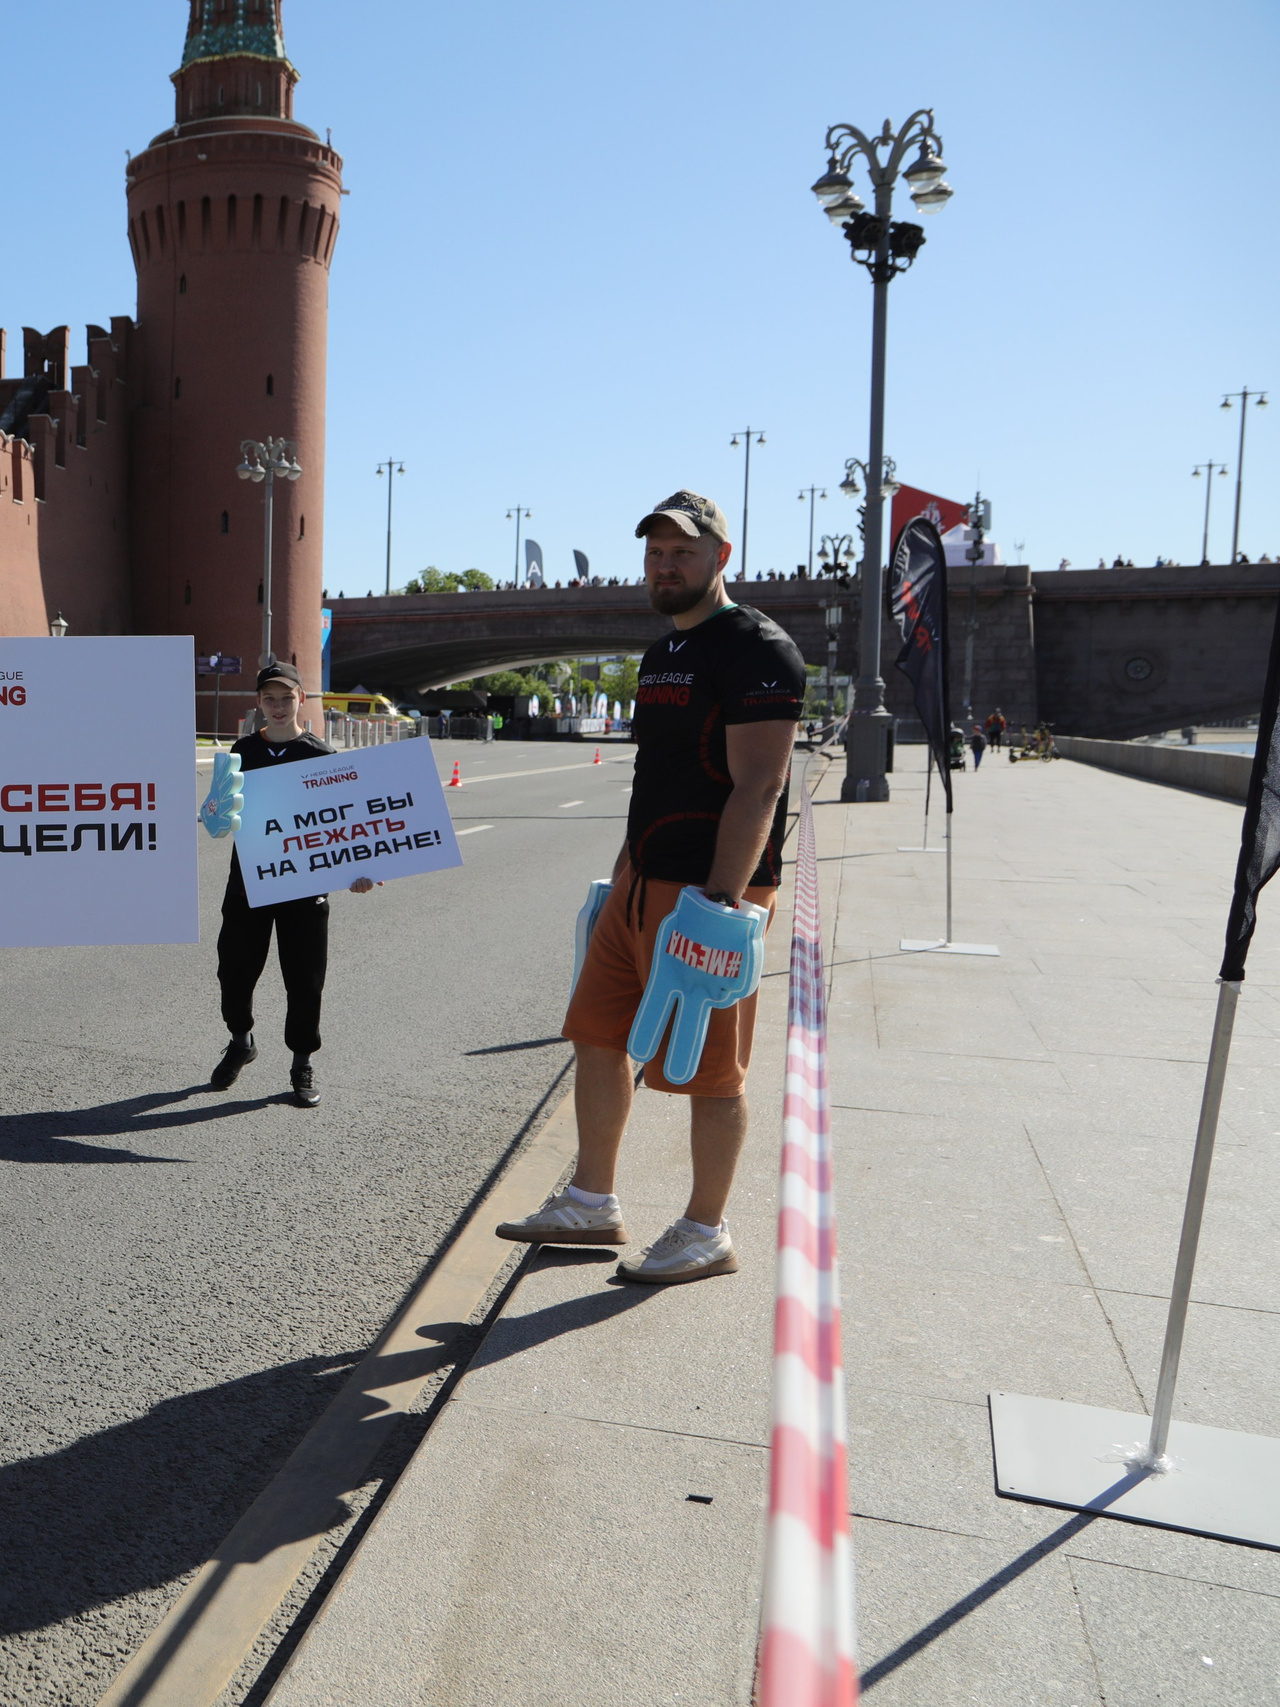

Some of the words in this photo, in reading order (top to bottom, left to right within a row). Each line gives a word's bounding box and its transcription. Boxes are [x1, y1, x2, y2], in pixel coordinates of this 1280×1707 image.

[656, 672, 695, 685] LEAGUE
[302, 770, 359, 790] TRAINING
[329, 764, 355, 774] LEAGUE
[0, 782, 156, 812] СЕБЯ!
[265, 818, 283, 835] А
[293, 803, 354, 830] МОГ
[366, 791, 414, 815] БЫ
[282, 817, 406, 854] ЛЕЖАТЬ
[256, 859, 298, 880] НА
[309, 829, 442, 872] ДИВАНЕ!
[667, 929, 743, 978] #МЕЧТА
